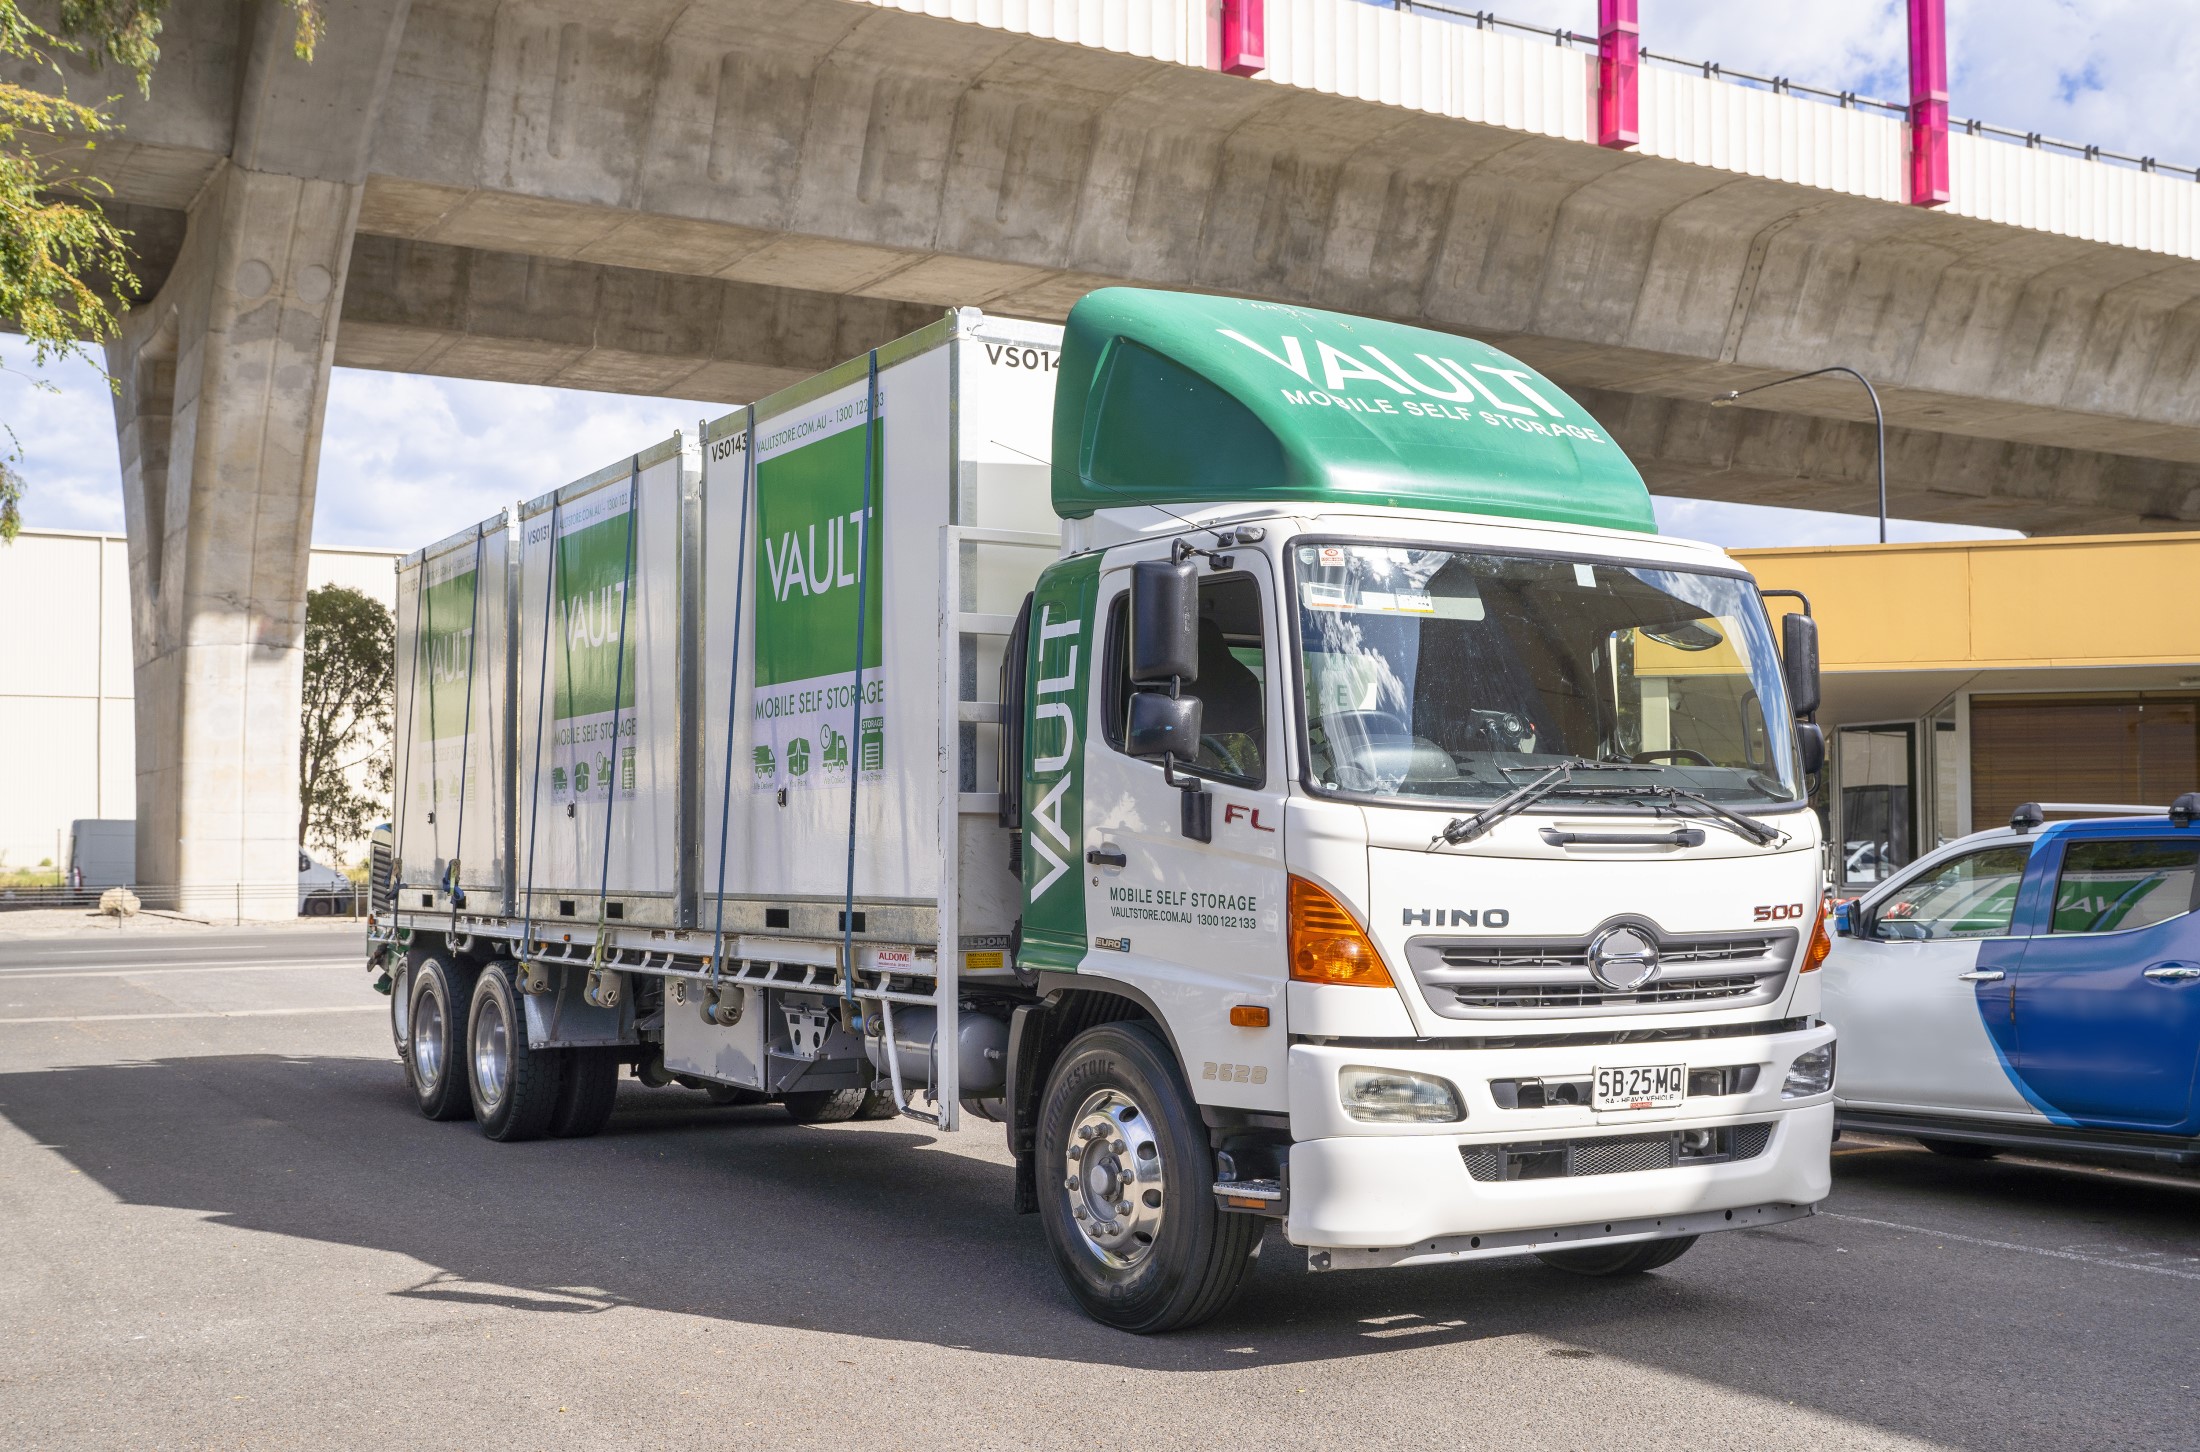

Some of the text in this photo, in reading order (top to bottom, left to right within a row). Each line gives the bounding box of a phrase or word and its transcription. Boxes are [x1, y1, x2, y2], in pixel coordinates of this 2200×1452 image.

[1216, 328, 1565, 419] VAULT
[756, 414, 827, 454] VAULTSTORE.COM.AU
[836, 404, 853, 424] 1300
[1280, 388, 1606, 444] MOBILE SELF STORAGE
[765, 506, 873, 602] VAULT
[561, 580, 630, 652] VAULT
[425, 627, 473, 685] VAULT
[755, 694, 795, 720] MOBILE
[798, 690, 822, 714] SELF
[554, 727, 580, 747] MOBILE
[582, 723, 598, 743] SELF
[862, 718, 883, 728] STORAGE
[1030, 605, 1081, 904] VAULT
[1224, 803, 1276, 833] FL
[1110, 886, 1257, 912] MOBILE SELF STORAGE
[1753, 903, 1803, 922] 500
[1111, 906, 1257, 929] VAULTSTORE.COM.AU 1300 122 133
[1403, 908, 1510, 928] HINO
[879, 952, 907, 961] ALDOM
[1202, 1061, 1268, 1085] 2628
